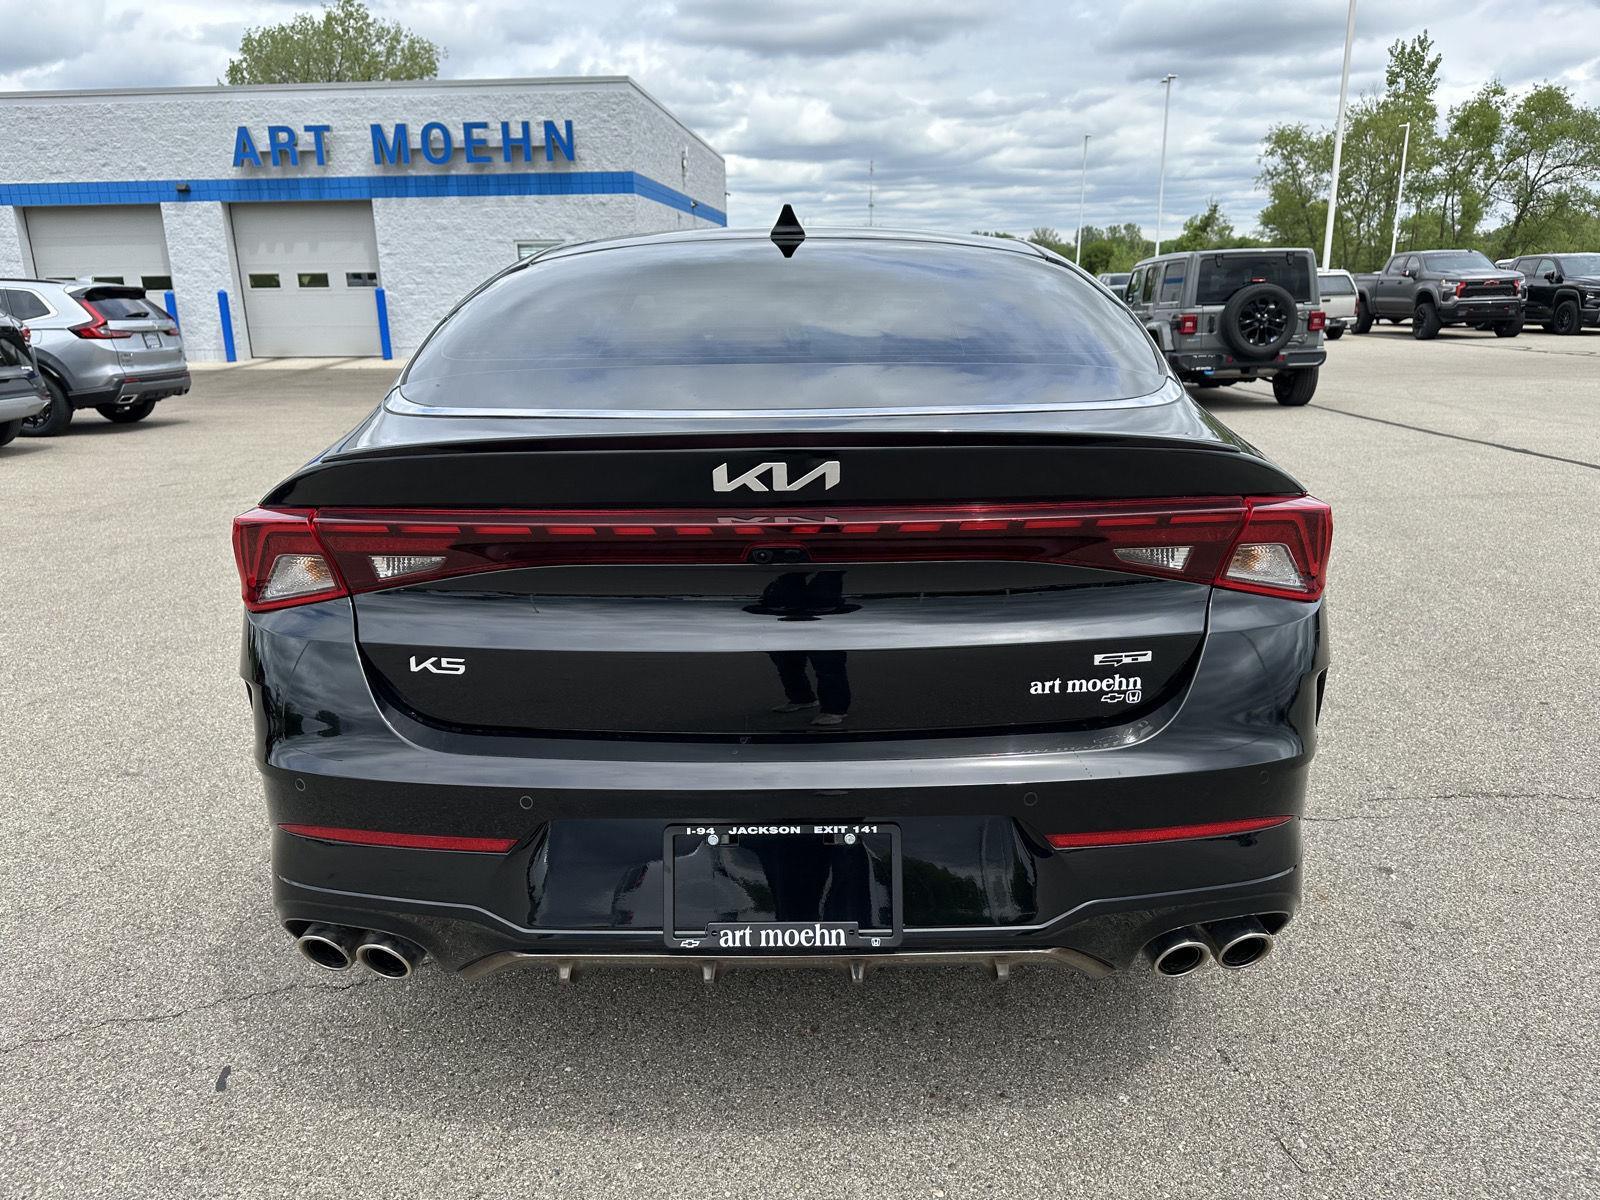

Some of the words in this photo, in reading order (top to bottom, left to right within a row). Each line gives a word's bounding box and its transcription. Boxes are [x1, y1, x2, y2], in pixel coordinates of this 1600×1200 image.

[232, 124, 331, 168] ART
[370, 119, 576, 166] MOEHN
[712, 460, 841, 492] KIA
[409, 655, 466, 675] K5
[1029, 677, 1062, 695] art
[1066, 673, 1142, 693] moehn
[686, 827, 716, 835] I-94
[728, 826, 801, 835] JACKSON
[813, 825, 848, 834] EXIT
[852, 825, 878, 834] 141
[718, 926, 753, 948] art
[758, 923, 847, 947] moehn
